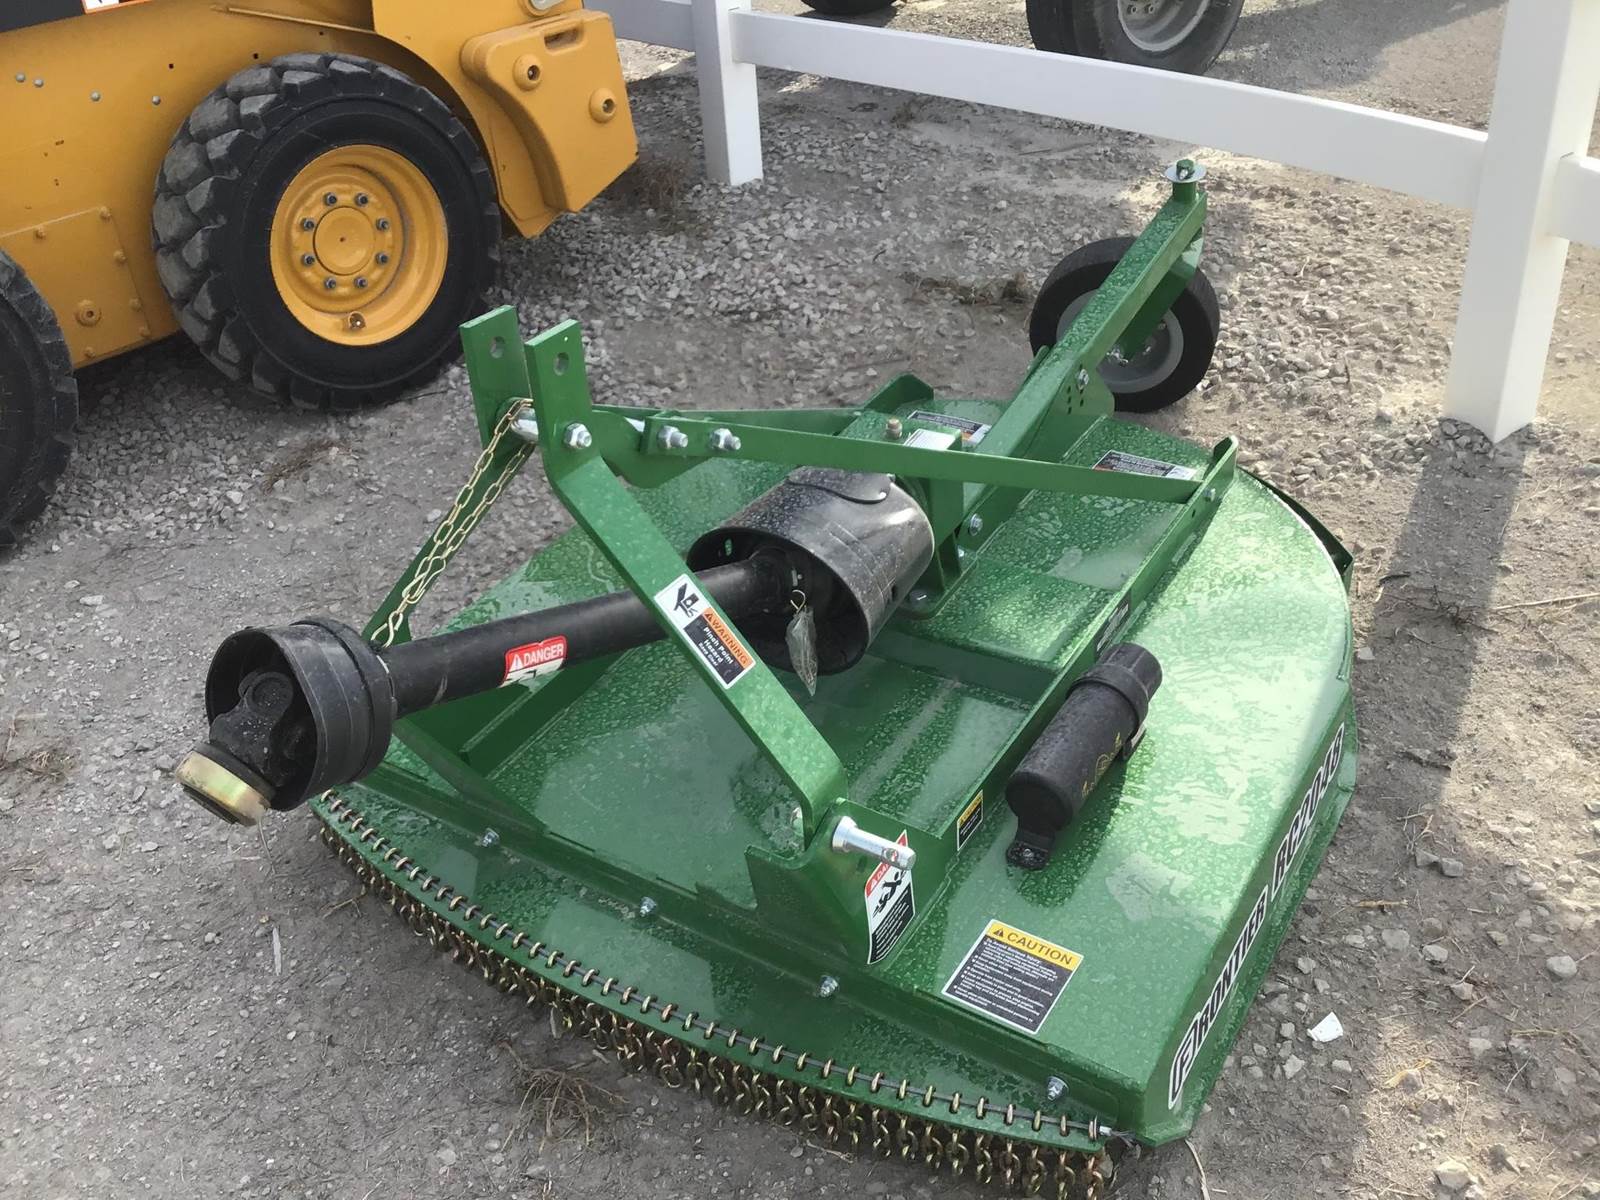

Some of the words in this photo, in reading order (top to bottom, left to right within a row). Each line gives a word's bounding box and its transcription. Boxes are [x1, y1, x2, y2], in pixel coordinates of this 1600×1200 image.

[523, 643, 564, 666] DANGER
[703, 626, 720, 647] Pinch
[718, 645, 734, 665] Point
[712, 620, 748, 665] WARNING
[1007, 932, 1073, 965] CAUTION
[1169, 888, 1267, 1108] FRONTIER
